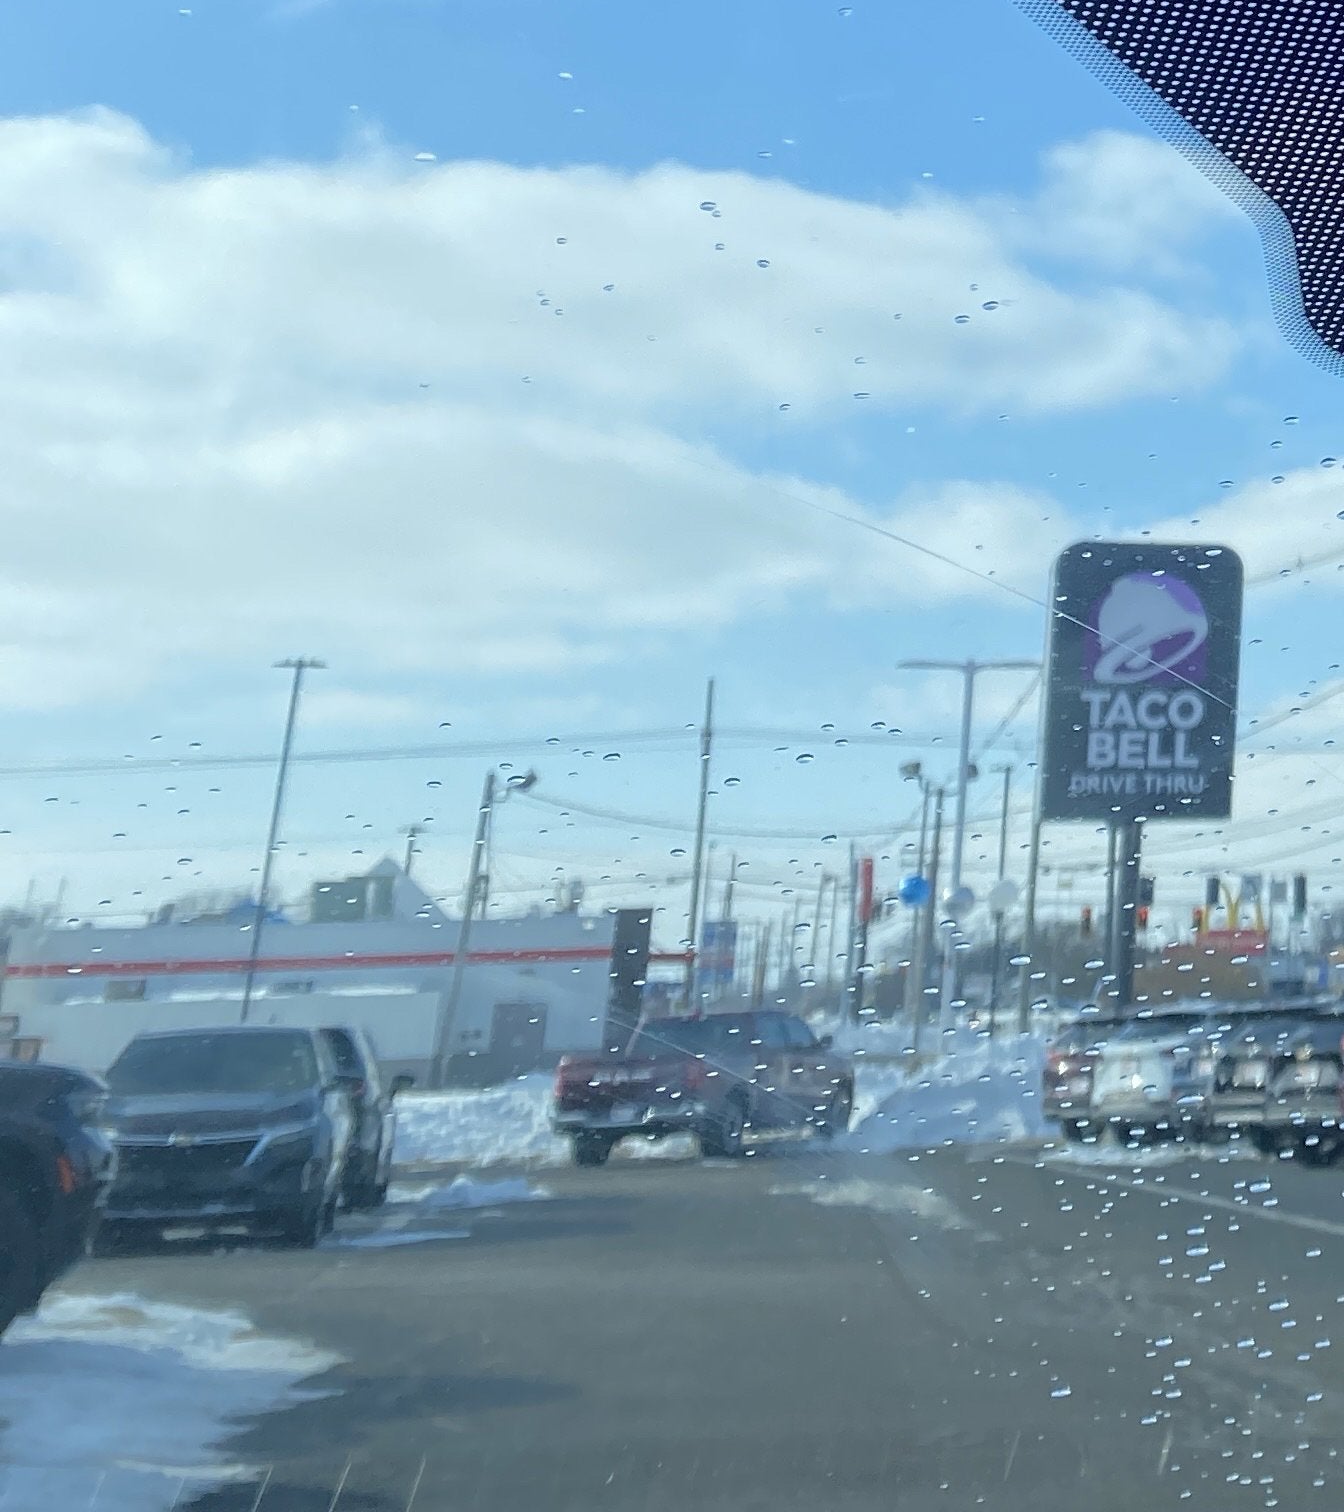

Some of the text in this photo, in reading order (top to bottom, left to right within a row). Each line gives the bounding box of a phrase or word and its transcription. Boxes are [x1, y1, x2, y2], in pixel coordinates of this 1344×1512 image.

[1080, 690, 1204, 730] TACO
[1087, 730, 1199, 769] BELL
[1070, 772, 1205, 795] DRIVE THRU
